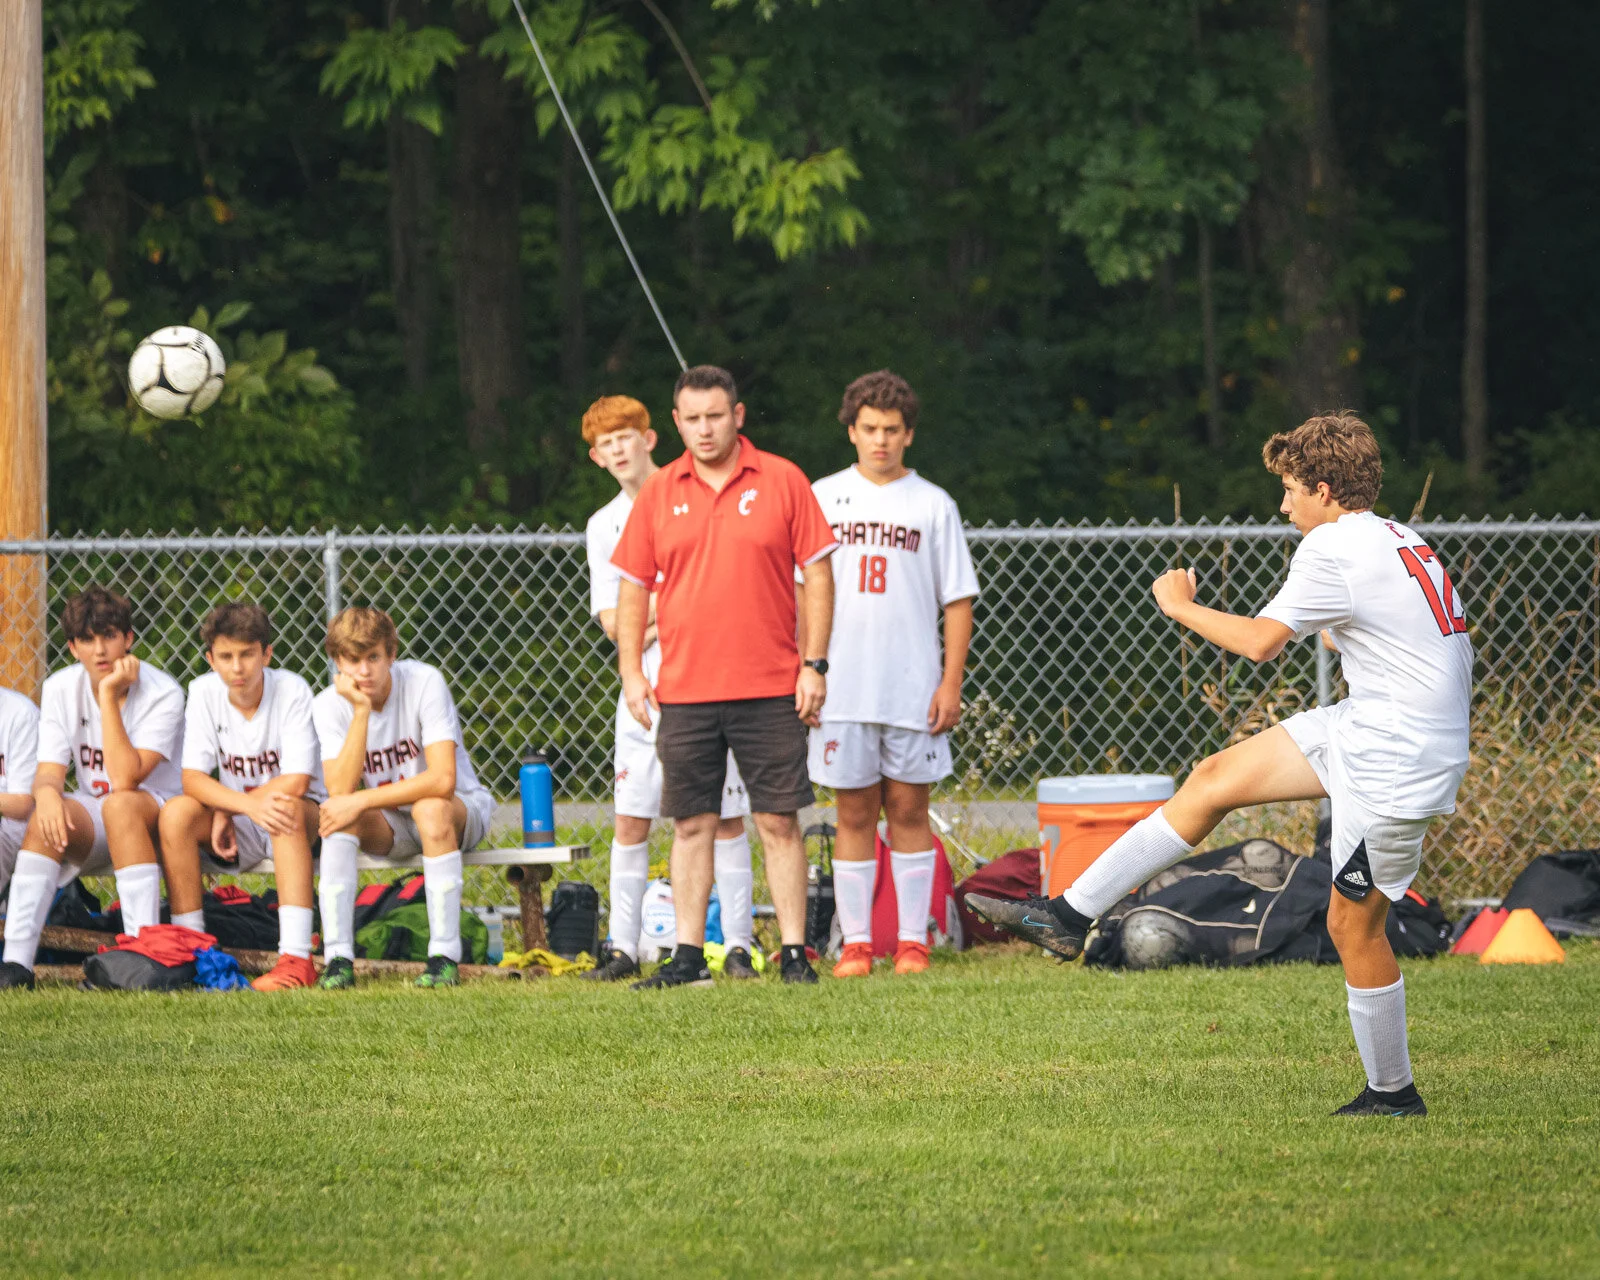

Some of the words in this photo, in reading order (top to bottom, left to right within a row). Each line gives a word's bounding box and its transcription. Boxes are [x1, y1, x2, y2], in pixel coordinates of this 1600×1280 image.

[858, 554, 887, 594] 18
[1397, 544, 1468, 637] 12
[219, 746, 280, 778] ATHA
[363, 736, 420, 775] ATHA
[1344, 873, 1369, 887] adidas
